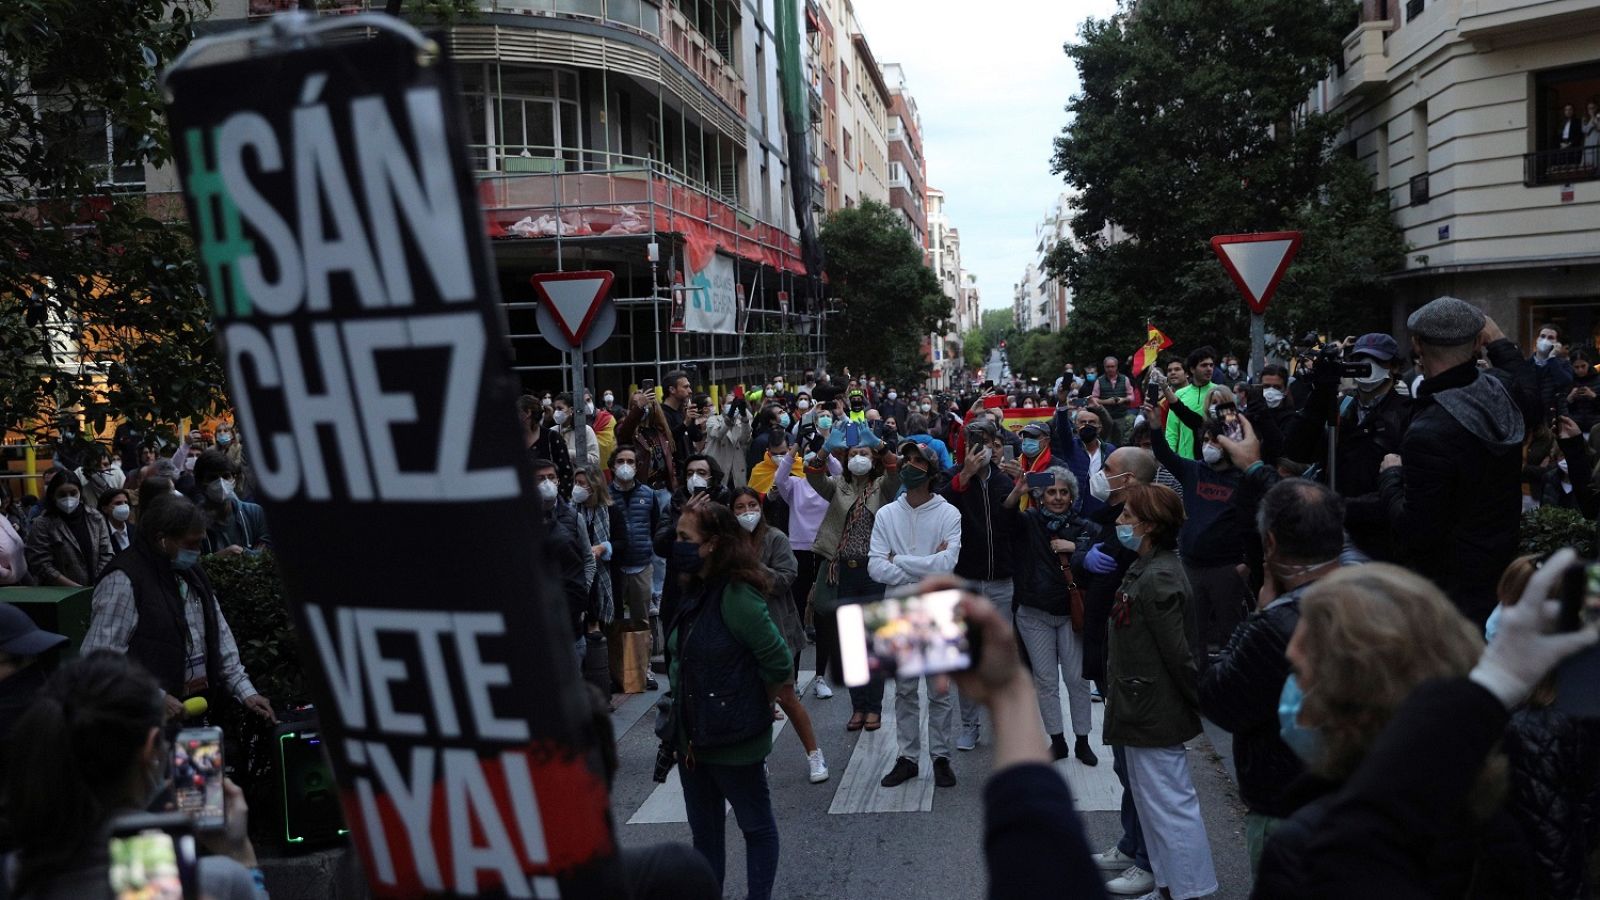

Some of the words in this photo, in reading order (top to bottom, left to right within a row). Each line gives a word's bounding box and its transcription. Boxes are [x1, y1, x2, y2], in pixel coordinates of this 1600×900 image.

[185, 73, 477, 317] #SÁN
[225, 311, 522, 501] CHEZ
[304, 602, 531, 742] VETE
[344, 737, 562, 900] ¡YA!
